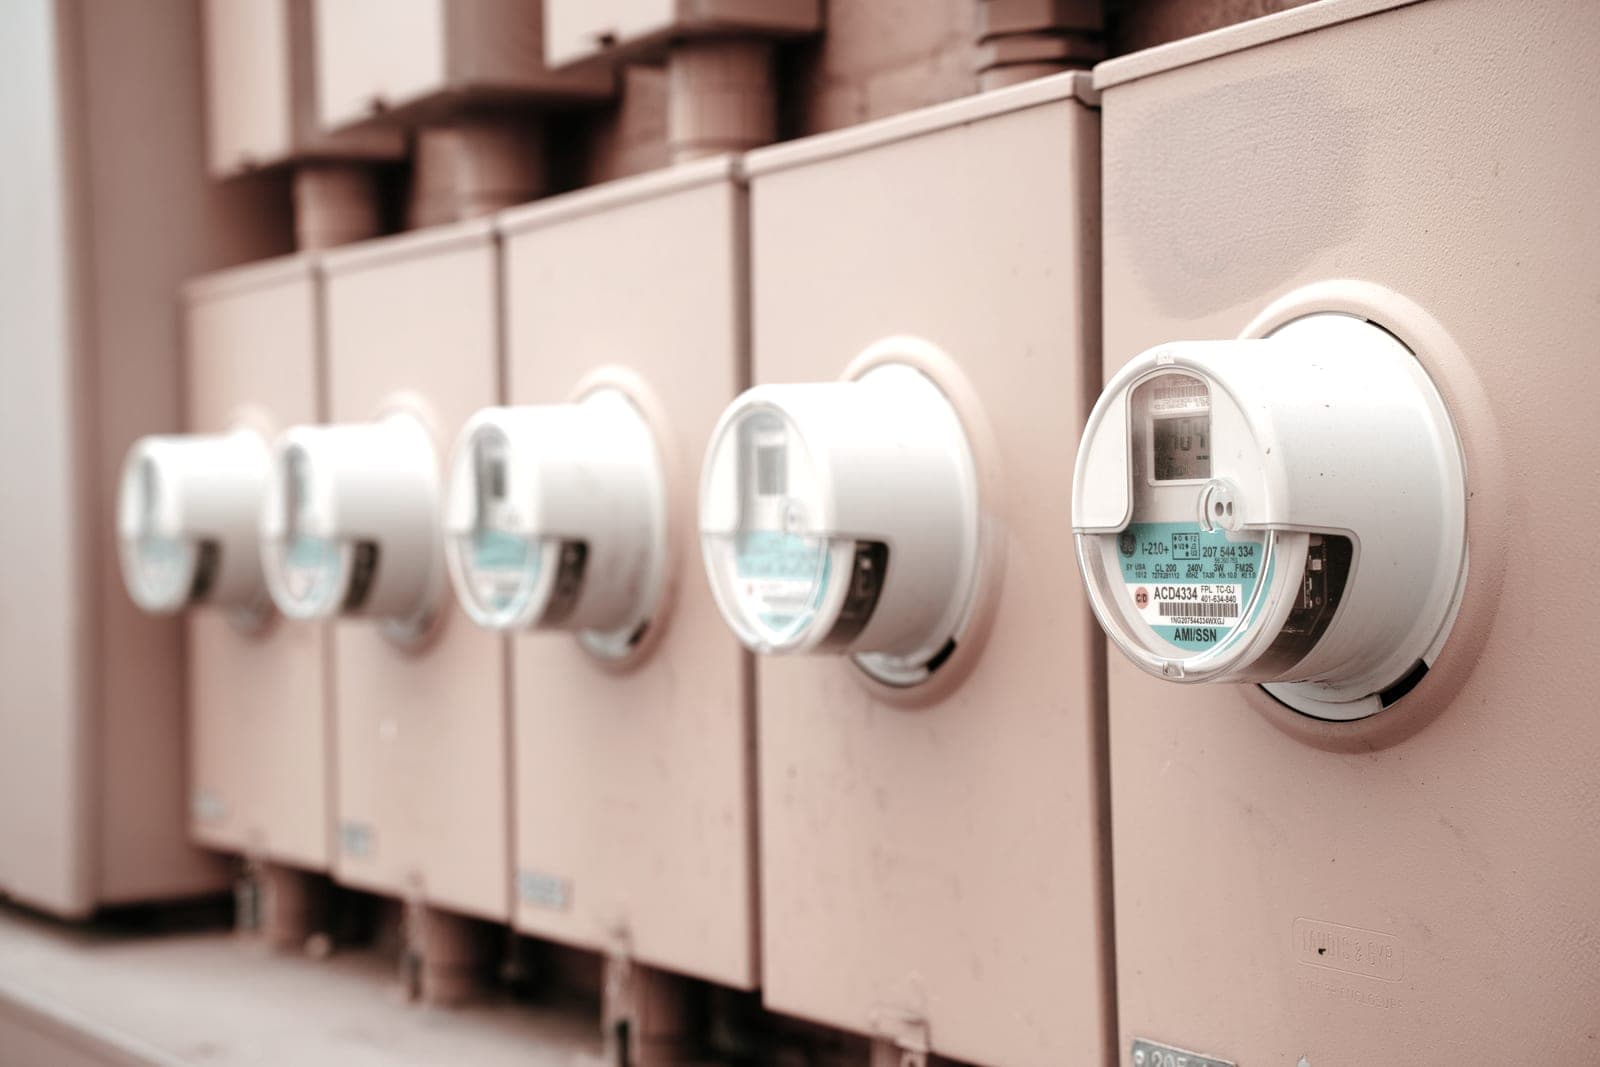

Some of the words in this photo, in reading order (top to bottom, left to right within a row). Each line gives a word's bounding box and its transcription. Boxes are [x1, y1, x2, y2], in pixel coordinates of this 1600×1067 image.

[1142, 542, 1169, 556] I-210+
[1202, 546, 1217, 558] 207
[1220, 546, 1235, 558] 544
[1238, 545, 1254, 558] 334
[1154, 563, 1165, 573] CL
[1165, 564, 1177, 573] 200
[1187, 563, 1203, 573] 240V
[1213, 564, 1225, 573] 3W
[1235, 563, 1254, 573] FM2S
[1154, 586, 1197, 601] ACD4334
[1200, 586, 1213, 594] FPL
[1215, 586, 1235, 594] TC-GJ
[1174, 628, 1217, 642] AMI/SSN
